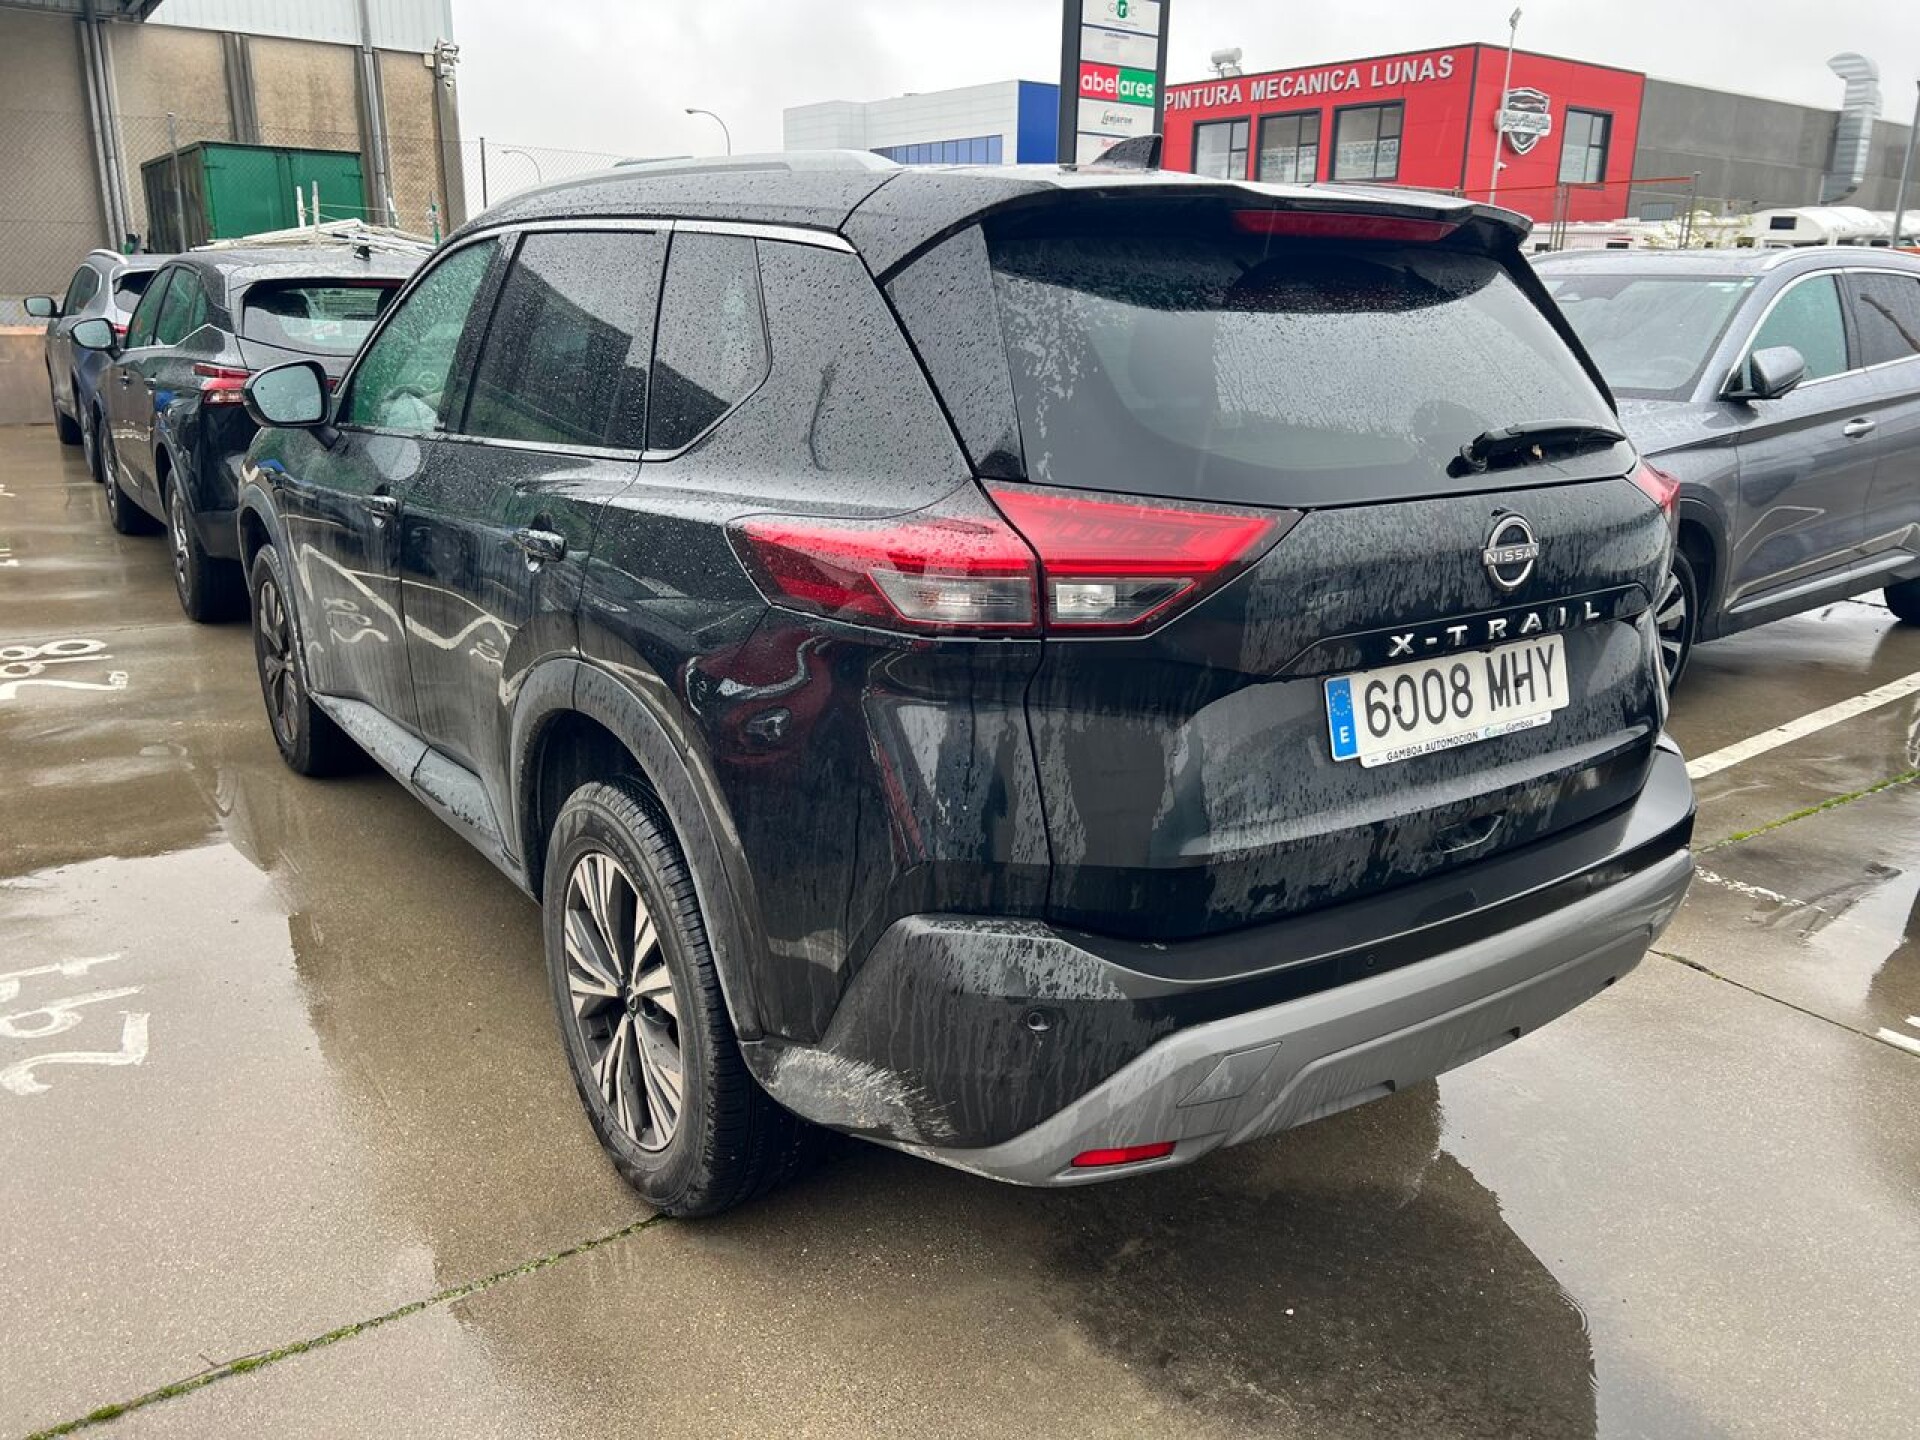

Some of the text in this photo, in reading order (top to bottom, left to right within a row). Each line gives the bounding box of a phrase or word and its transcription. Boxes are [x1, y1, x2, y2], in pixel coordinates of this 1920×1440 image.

[1081, 71, 1154, 98] abelares
[1164, 54, 1454, 112] PINTURA MECANICA LUNAS
[1484, 543, 1539, 565] NISSAN
[1388, 601, 1600, 658] X-TRAIL
[1364, 643, 1555, 739] 6008 MHY
[1340, 726, 1350, 744] E
[1386, 745, 1423, 762] GAMBOA
[1424, 731, 1479, 753] AUTOMOCION
